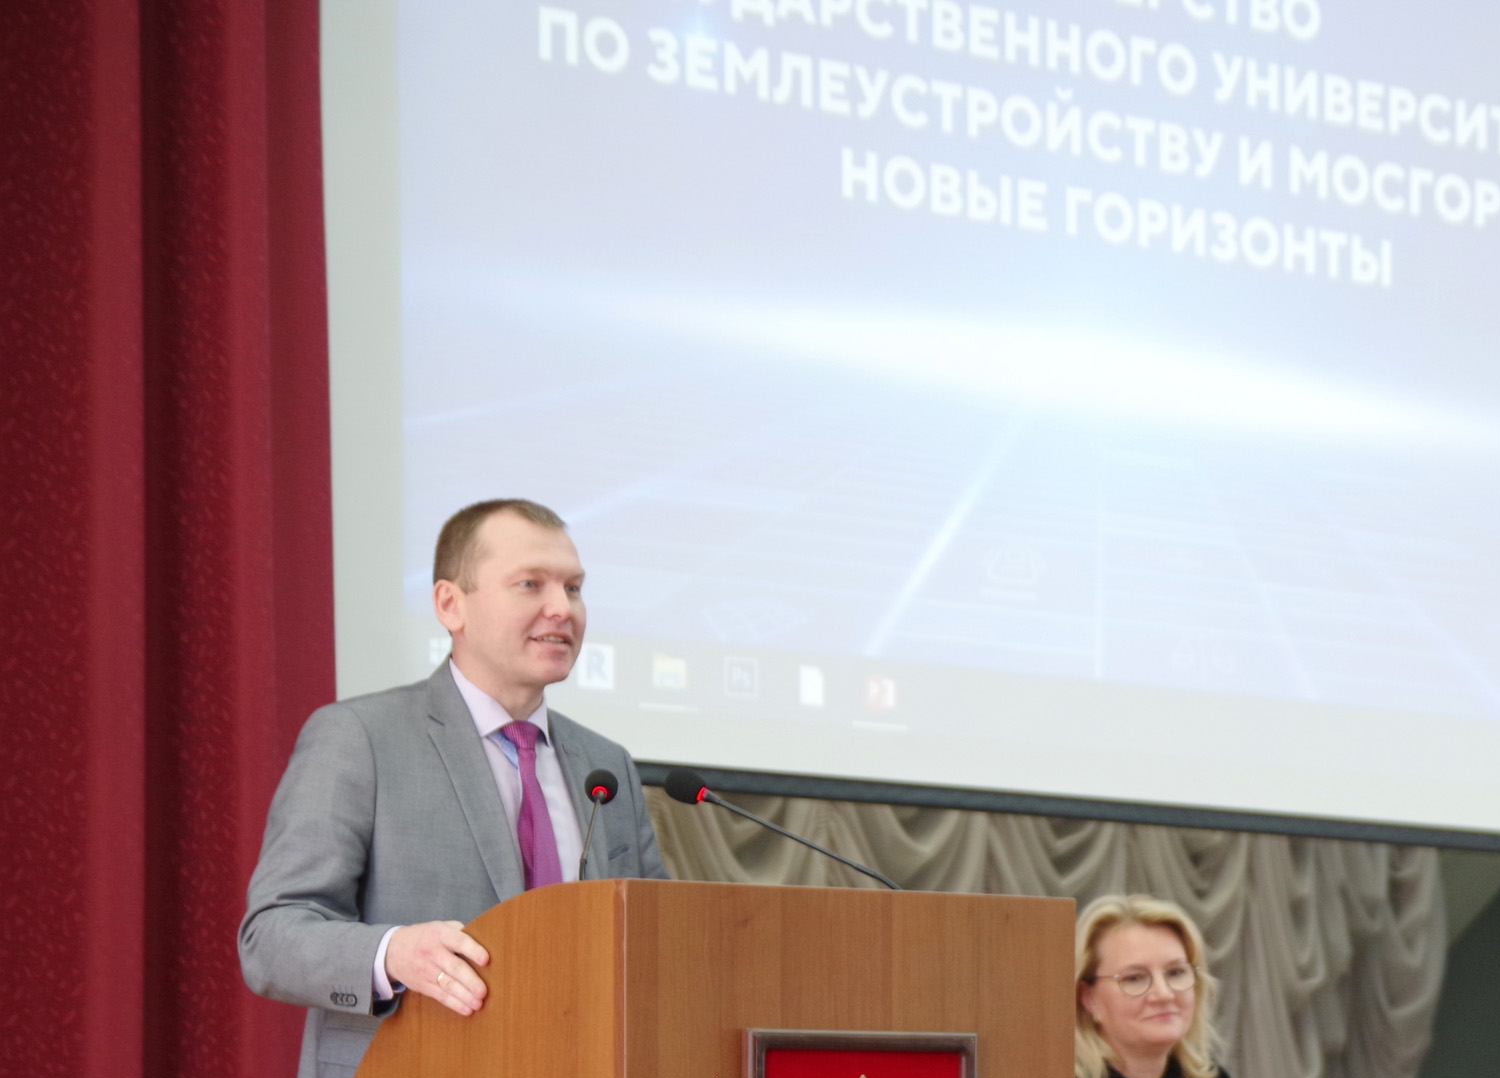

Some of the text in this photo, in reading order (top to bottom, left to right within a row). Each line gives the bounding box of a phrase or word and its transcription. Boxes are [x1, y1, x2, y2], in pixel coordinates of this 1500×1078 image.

[540, 6, 630, 73] ПО
[647, 28, 1223, 177] ЗЕМЛЕУСТРОЙСТВУ
[1239, 138, 1272, 189] И
[842, 147, 1392, 286] НОВЫЕ ГОРИЗОНТЫ
